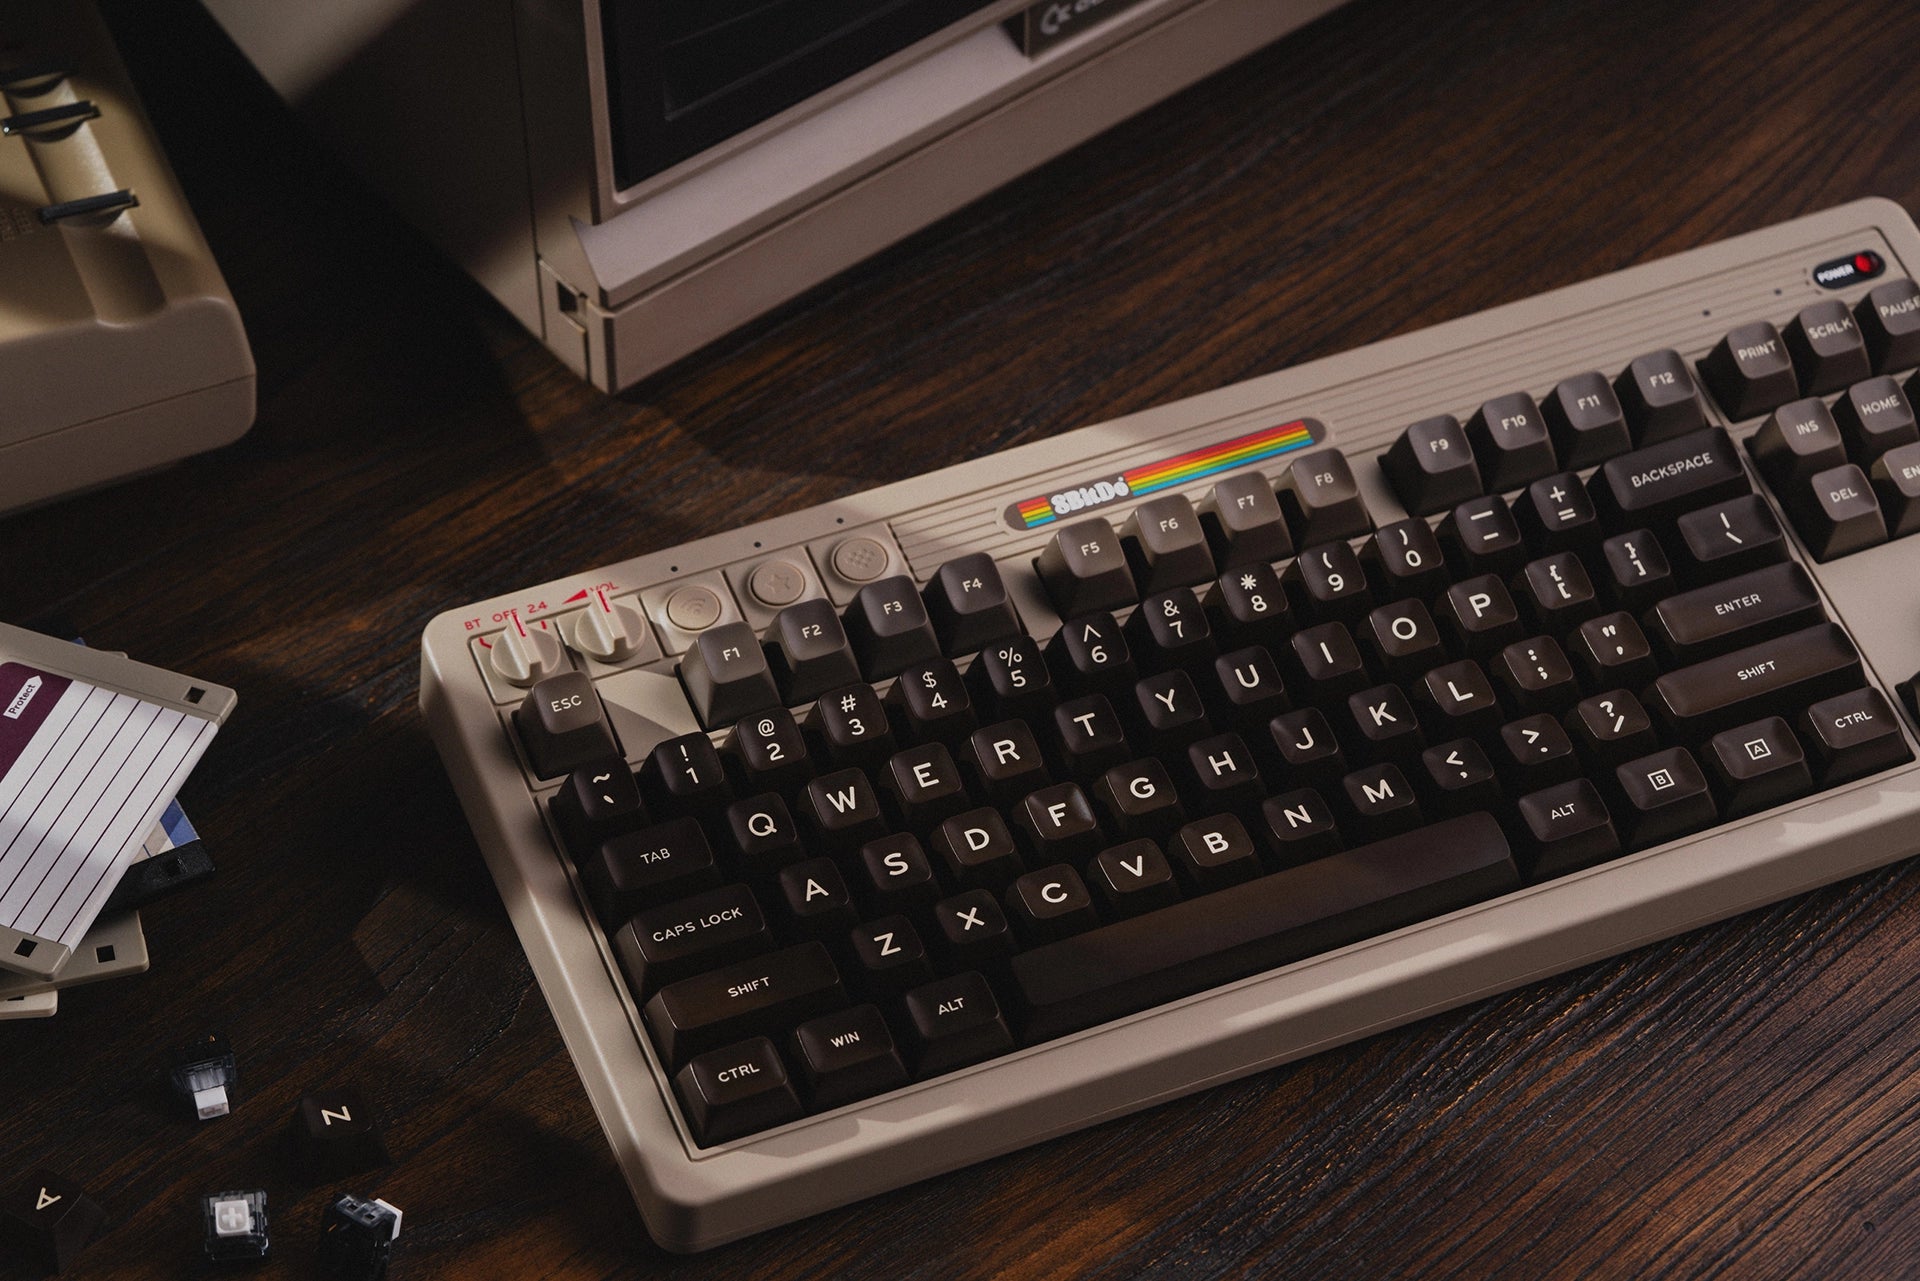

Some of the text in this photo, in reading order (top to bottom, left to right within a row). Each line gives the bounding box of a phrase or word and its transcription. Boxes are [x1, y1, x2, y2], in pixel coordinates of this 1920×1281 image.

[1817, 264, 1855, 283] POWER
[1807, 319, 1852, 340] SCRLK
[1737, 340, 1775, 361] PRINT
[1649, 371, 1675, 388] F12
[1577, 394, 1601, 411] F11
[1861, 395, 1900, 416] HOME
[1501, 414, 1527, 431] F10
[1795, 420, 1819, 436] INS
[1429, 438, 1449, 453] F9
[1314, 472, 1334, 487] F8
[1631, 452, 1713, 488] BACKSPACE
[1050, 476, 1130, 515] 8BitDo
[1236, 494, 1255, 510] F7
[1549, 485, 1566, 503] +
[1829, 487, 1858, 503] DEL
[1159, 517, 1179, 533] F6
[1398, 528, 1409, 546] )
[1080, 541, 1100, 556] F5
[1322, 552, 1333, 569] (
[962, 577, 983, 593] F4
[1327, 573, 1344, 592] 9
[527, 601, 548, 614] 2.4
[883, 600, 903, 615] F3
[1163, 599, 1180, 617] &
[1251, 594, 1268, 612] 8
[1468, 593, 1491, 618] P
[1714, 593, 1762, 615] ENTER
[464, 618, 481, 630] BT
[801, 624, 823, 639] F2
[1169, 620, 1184, 638] 7
[1391, 617, 1417, 640] O
[722, 646, 741, 661] F1
[998, 646, 1023, 667] %
[1091, 645, 1108, 663] 6
[922, 671, 937, 689] $
[1010, 669, 1026, 688] 5
[1234, 664, 1260, 688] U
[1737, 660, 1776, 681] SHIFT
[8, 684, 36, 714] Protect
[931, 692, 948, 709] 4
[1154, 688, 1176, 713] Y
[1447, 681, 1474, 702] L
[550, 694, 582, 713] ESC
[840, 694, 857, 713] #
[1599, 700, 1615, 718] ?
[1368, 701, 1397, 727] K
[1834, 710, 1873, 729] CTRL
[757, 718, 775, 737] @
[848, 718, 865, 736] 3
[1073, 712, 1096, 737] T
[1295, 727, 1314, 750] J
[680, 744, 689, 762] !
[766, 742, 785, 761] 2
[993, 739, 1021, 765] R
[1208, 750, 1237, 776] H
[685, 767, 699, 784] 1
[912, 762, 940, 788] E
[1129, 777, 1156, 799] G
[1361, 778, 1395, 804] M
[825, 786, 856, 813] W
[1047, 802, 1066, 827] F
[1283, 804, 1313, 828] N
[1551, 803, 1575, 820] ALT
[748, 812, 778, 837] Q
[963, 828, 990, 851] D
[1202, 832, 1229, 854] B
[640, 847, 671, 864] TAB
[883, 852, 909, 876] S
[1119, 855, 1143, 877] V
[806, 878, 829, 902] A
[1041, 882, 1068, 903] C
[652, 907, 743, 942] CAPS LOCK
[956, 906, 985, 931] X
[873, 932, 902, 956] Z
[727, 976, 769, 998] SHIFT
[938, 997, 964, 1016] ALT
[830, 1031, 860, 1048] WIN
[718, 1063, 760, 1083] CTRL
[35, 1187, 62, 1210] A
